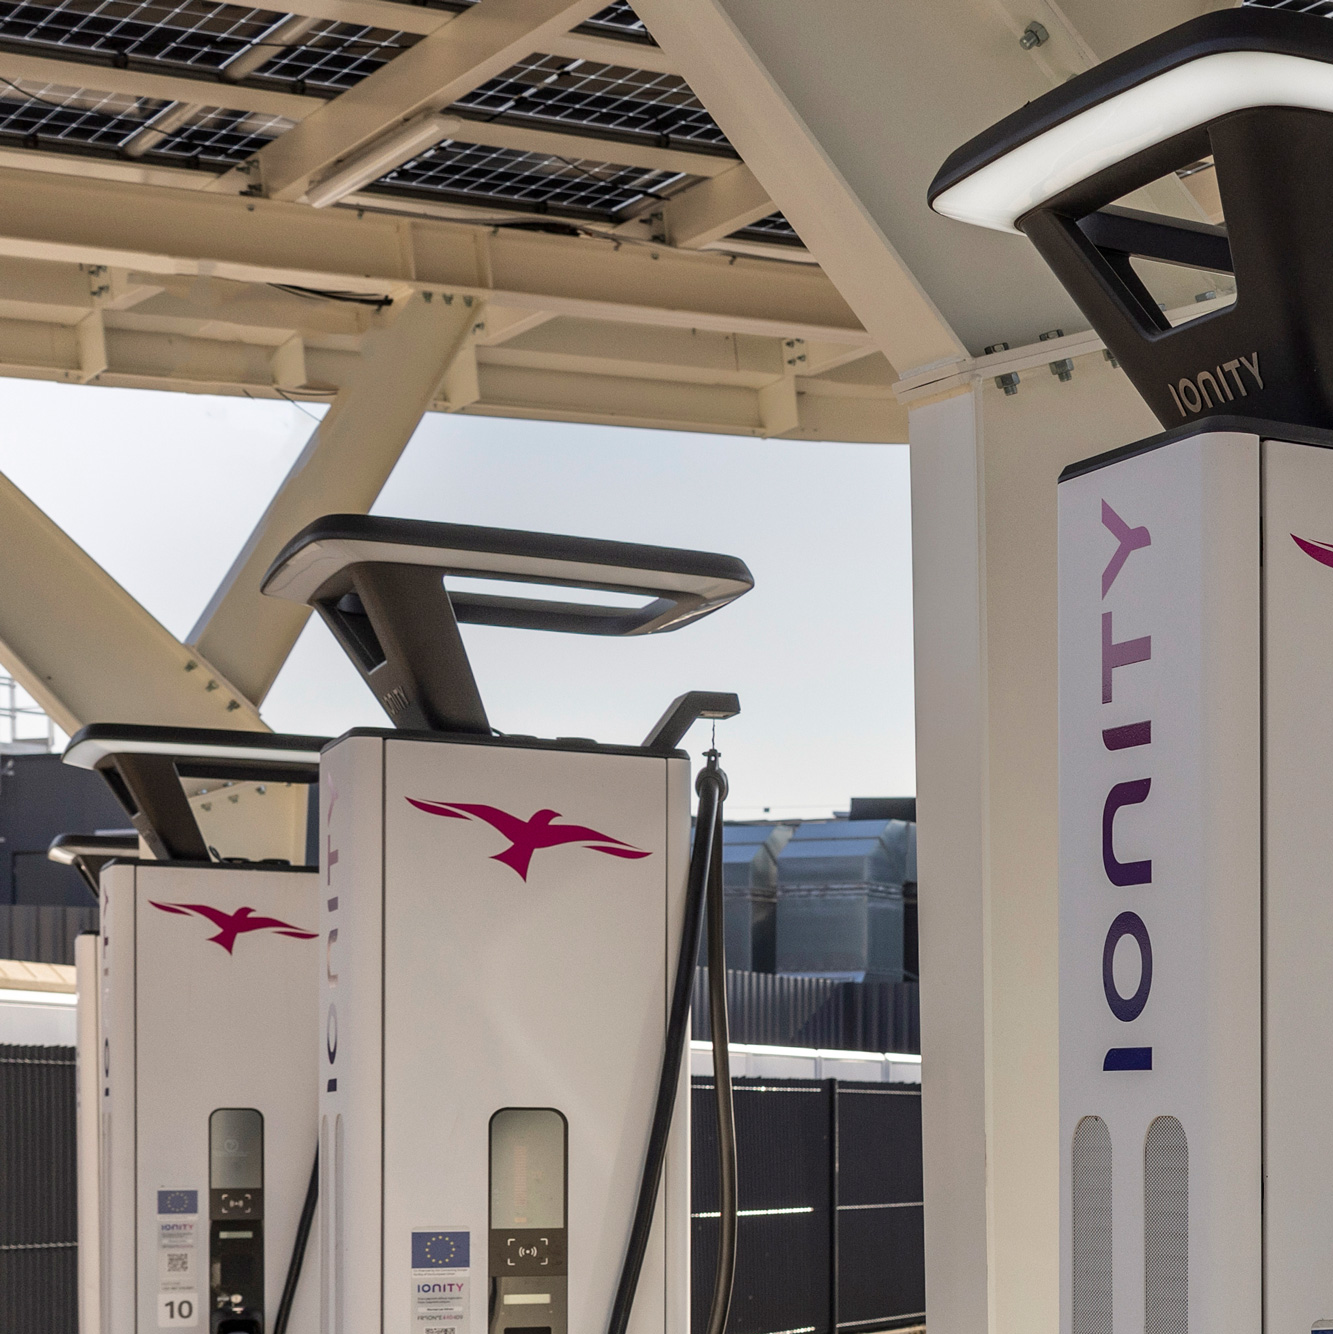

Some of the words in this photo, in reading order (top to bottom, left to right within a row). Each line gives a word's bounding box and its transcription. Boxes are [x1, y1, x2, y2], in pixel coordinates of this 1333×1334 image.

[1167, 352, 1264, 417] IONITY
[1101, 499, 1153, 1072] IONITY
[417, 1283, 464, 1293] IONITY
[164, 1300, 193, 1319] 10
